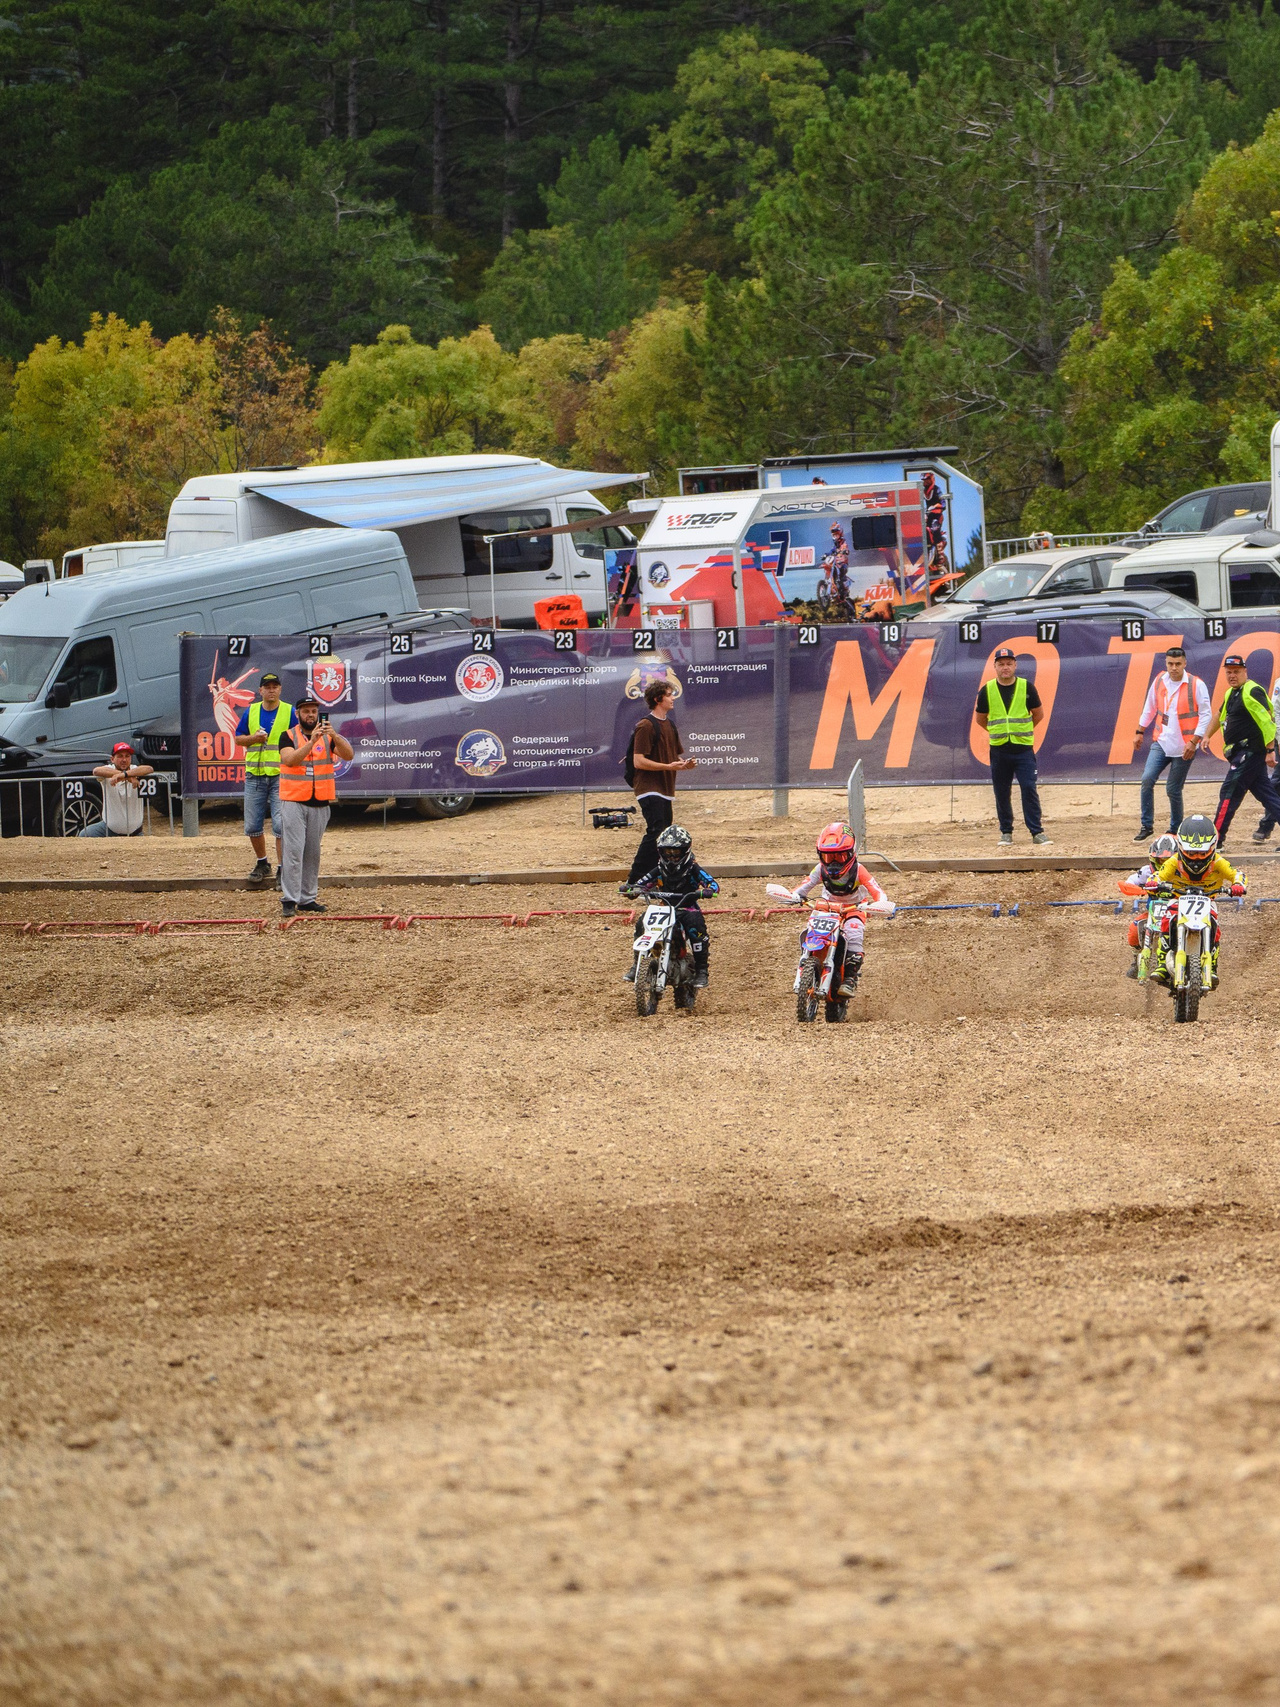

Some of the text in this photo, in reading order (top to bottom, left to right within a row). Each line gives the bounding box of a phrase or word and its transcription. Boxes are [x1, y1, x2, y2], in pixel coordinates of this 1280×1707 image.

[682, 512, 738, 526] RGP
[770, 530, 790, 577] 7
[864, 584, 895, 602] KTM
[800, 627, 817, 643] 20
[882, 625, 899, 641] 19
[962, 624, 978, 640] 18
[1040, 624, 1055, 640] 17
[1125, 622, 1141, 638] 16
[1207, 620, 1223, 636] 15
[230, 638, 246, 654] 27
[311, 637, 328, 653] 26
[393, 636, 409, 651] 25
[474, 634, 491, 650] 24
[556, 632, 573, 648] 23
[634, 632, 652, 649] 22
[718, 630, 734, 647] 21
[510, 665, 617, 674] Министерство спорта
[687, 663, 767, 673] Администрация
[359, 674, 447, 684] Республика Крым
[510, 677, 600, 687] Республики Крым
[696, 676, 719, 684] Ялта
[360, 738, 417, 747] Федерация
[512, 735, 569, 744] Федерация
[689, 732, 745, 741] Федерация
[197, 731, 231, 761] 80
[513, 746, 593, 756] мотоциклетного
[361, 750, 441, 758] мотоциклетного
[725, 756, 759, 765] Крыма
[362, 762, 396, 771] спорта
[398, 761, 433, 769] России
[513, 759, 547, 768] спорта
[558, 759, 581, 767] Ялта
[198, 766, 246, 783] ПОБЕД
[66, 782, 83, 798] 29
[140, 779, 156, 796] 28
[1186, 901, 1205, 915] 72
[647, 912, 670, 925] 57
[812, 919, 836, 931] 333
